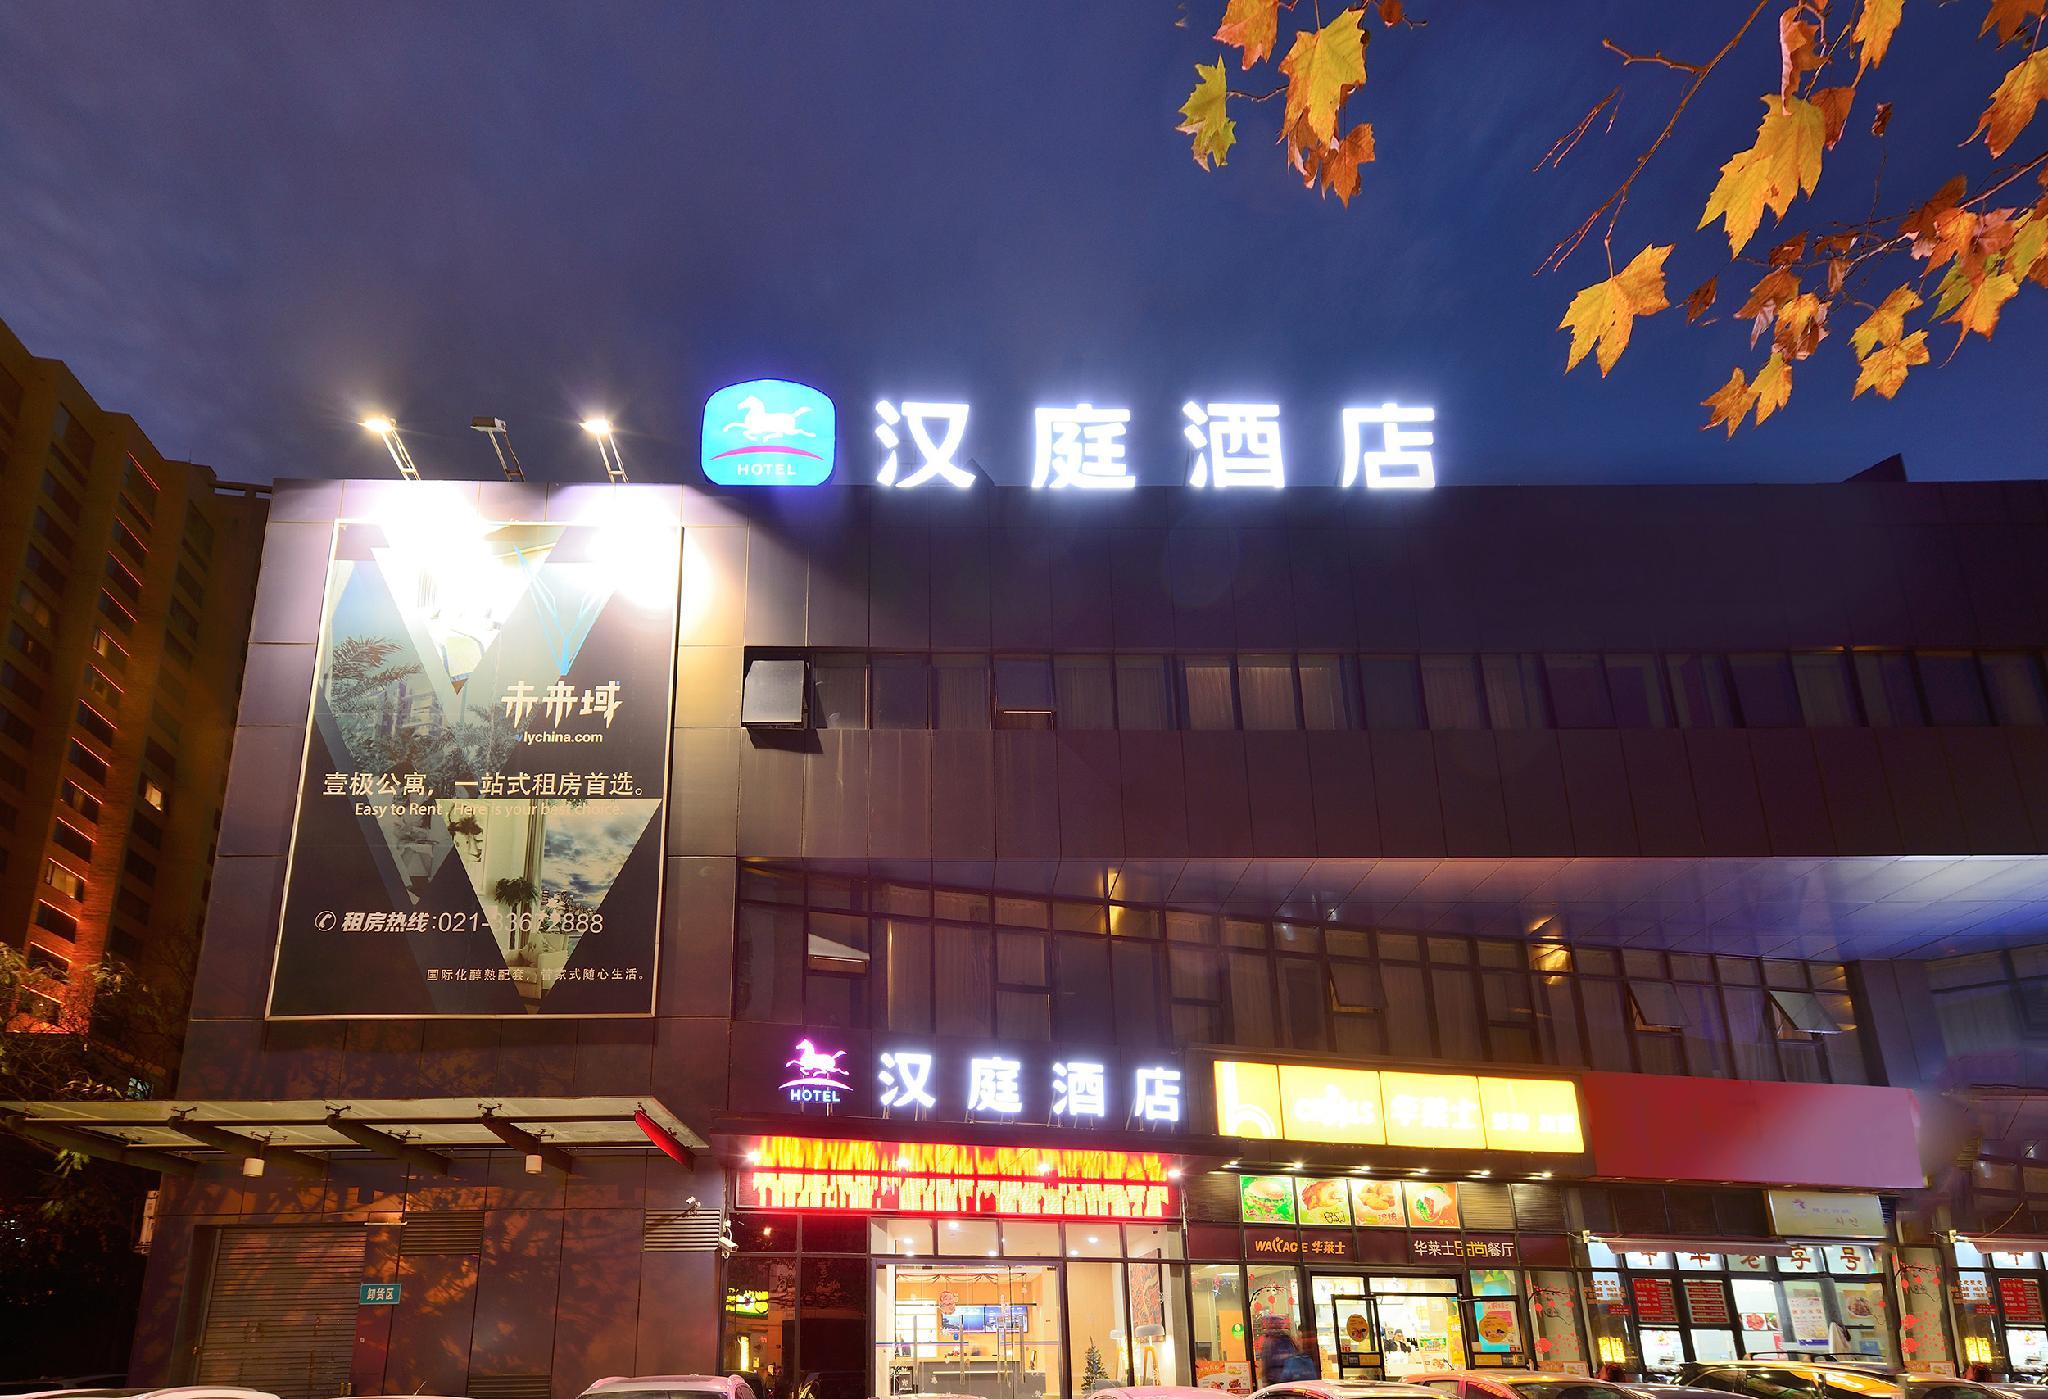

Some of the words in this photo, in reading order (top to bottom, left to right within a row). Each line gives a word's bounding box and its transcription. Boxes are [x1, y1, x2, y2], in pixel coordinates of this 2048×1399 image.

[874, 399, 1437, 490] 汉庭酒店
[736, 463, 797, 477] HOTEL
[500, 680, 624, 729] 未来域
[322, 771, 644, 797] 壹极公寓，一站式租房首选。
[354, 802, 388, 818] Easy
[390, 803, 407, 817] to
[409, 802, 443, 817] Rent
[453, 802, 487, 817] Here
[491, 802, 502, 816] is
[504, 804, 539, 819] your
[540, 802, 573, 817] best
[789, 1087, 841, 1104] HOTEL
[878, 1052, 1181, 1122] 汉庭酒店
[1311, 1239, 1346, 1255] 华莱士
